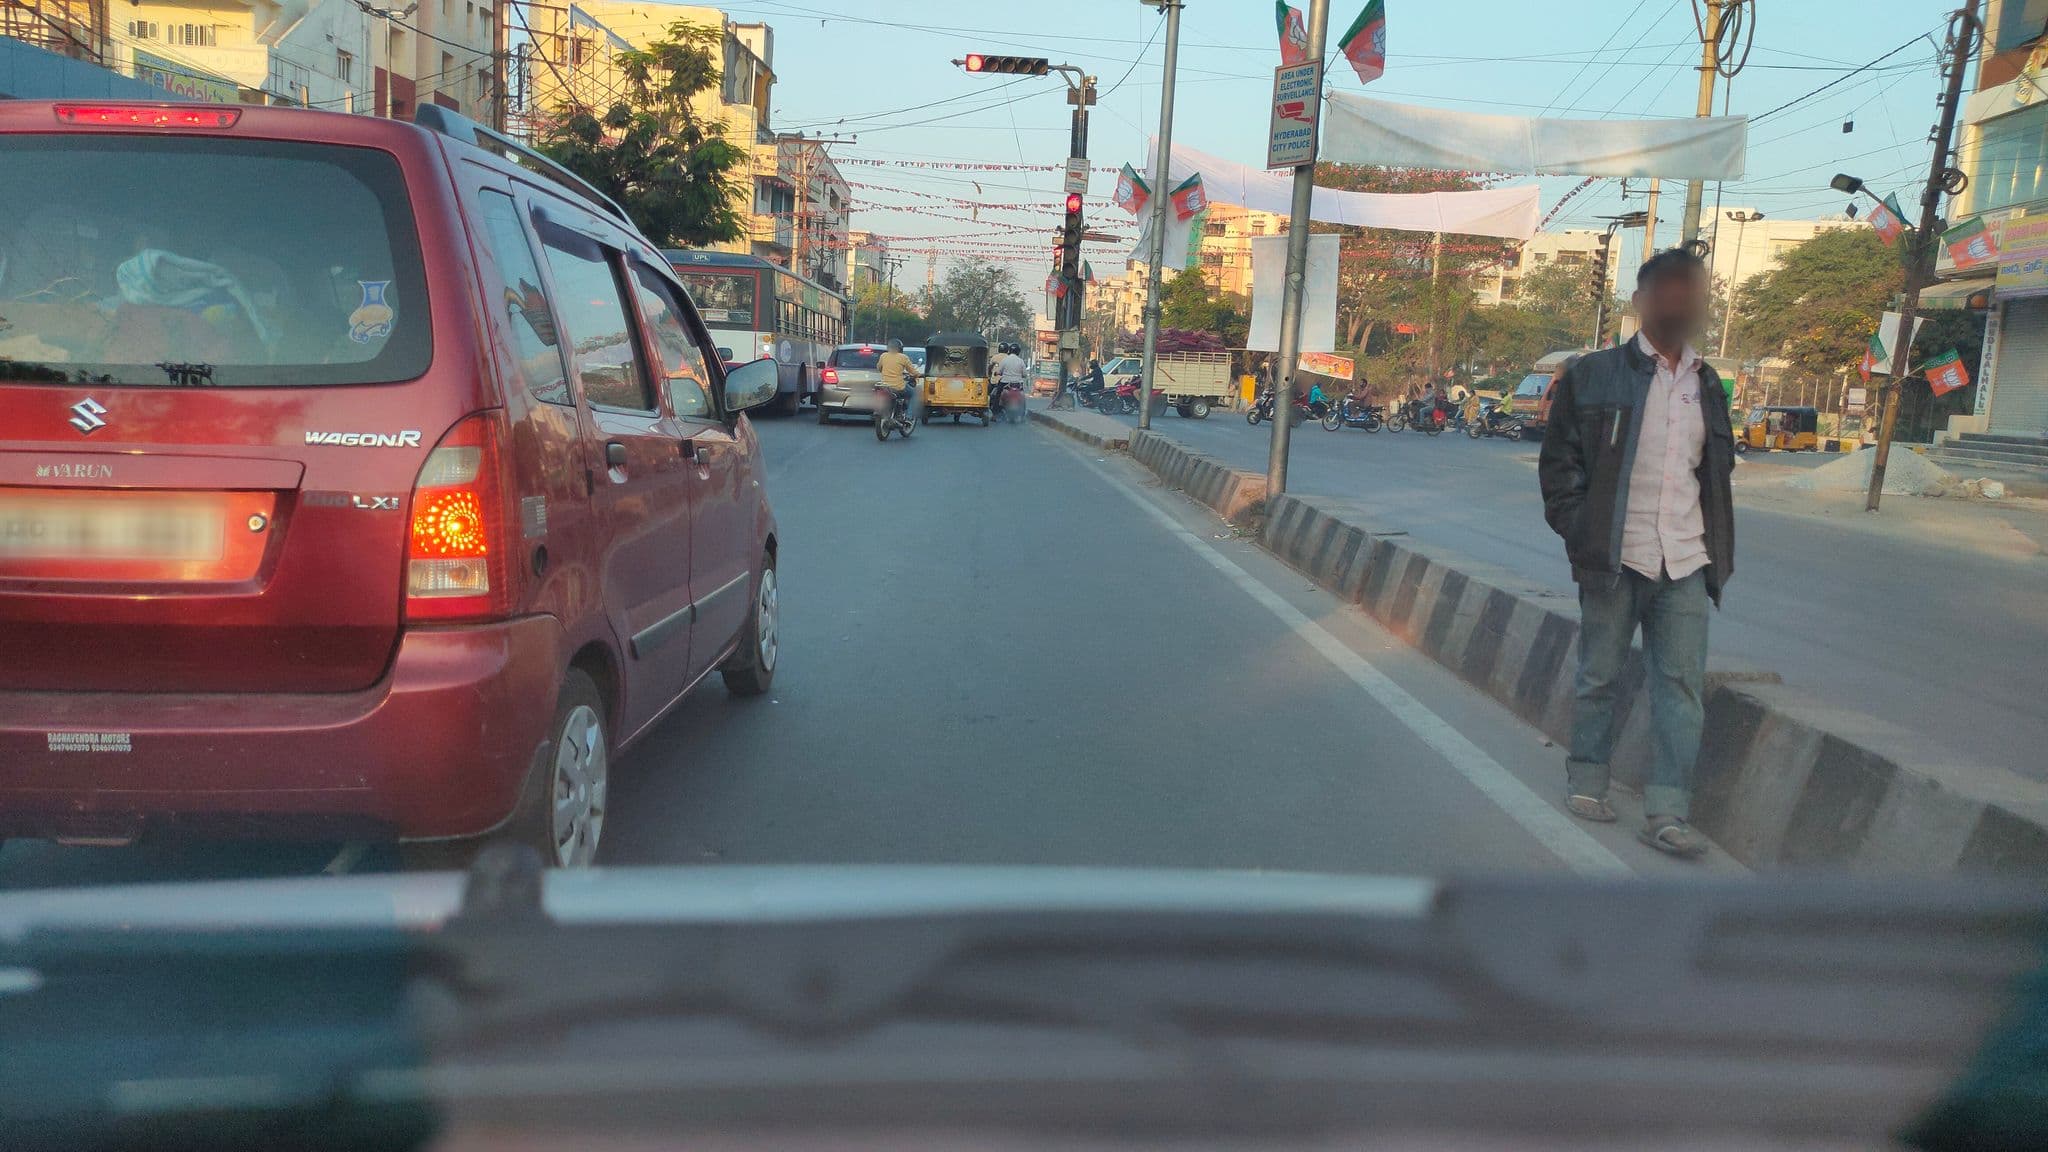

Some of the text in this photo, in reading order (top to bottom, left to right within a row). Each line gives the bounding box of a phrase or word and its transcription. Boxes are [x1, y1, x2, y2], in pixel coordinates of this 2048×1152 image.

[1296, 67, 1313, 77] UNDER
[1280, 78, 1312, 90] ELECTRONIC
[1277, 88, 1315, 101] SURVEILLANCE
[1274, 128, 1311, 140] HYDERABAD
[1272, 140, 1311, 152] CITY POLICE
[53, 463, 113, 478] VARUN
[101, 733, 131, 744] MOTORS
